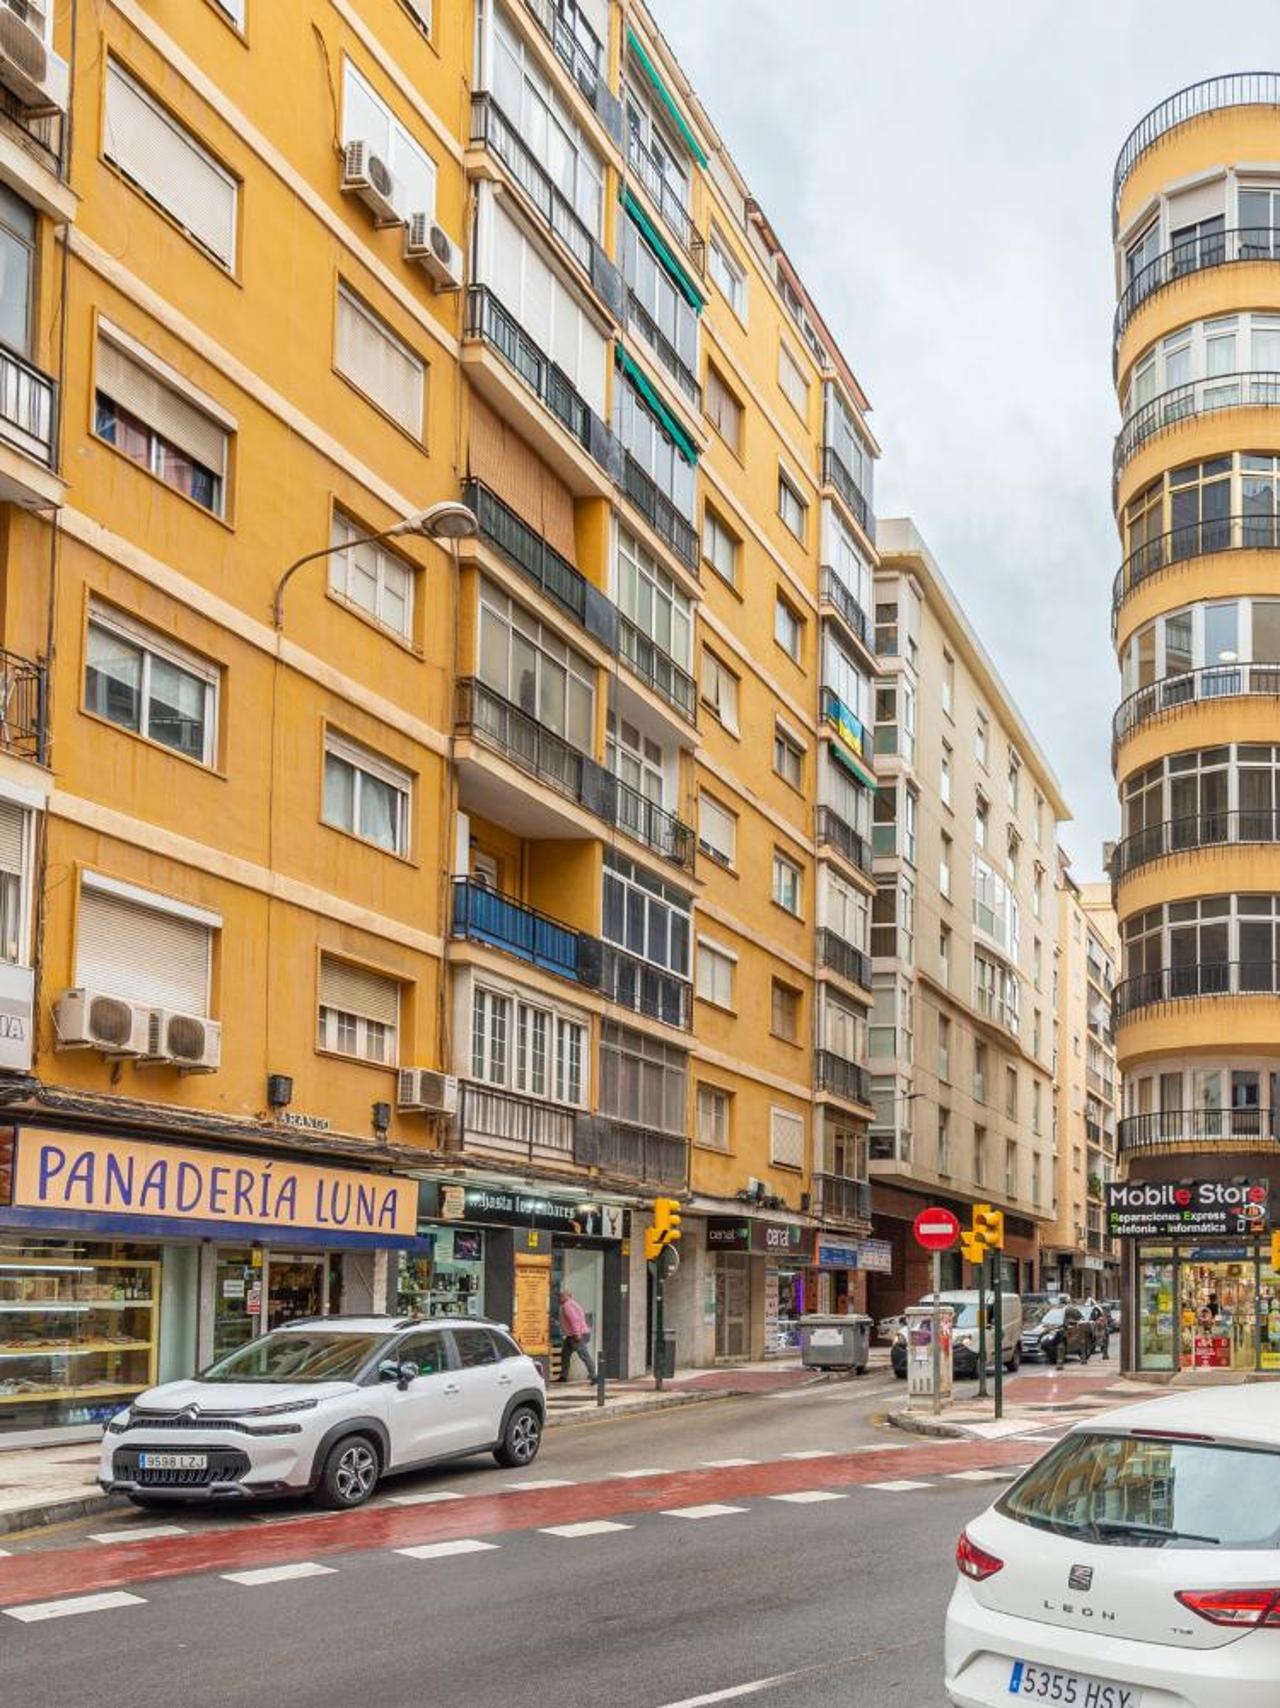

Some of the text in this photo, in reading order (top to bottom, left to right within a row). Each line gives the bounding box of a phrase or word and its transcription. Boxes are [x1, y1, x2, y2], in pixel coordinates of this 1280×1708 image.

[38, 1145, 298, 1221] PANADERÍA
[315, 1177, 399, 1230] LUNA
[1110, 1183, 1266, 1206] Mobile Store
[1111, 1210, 1227, 1223] Reparaciones Express
[180, 1456, 205, 1468] LZJ
[1044, 1600, 1115, 1620] LEON
[1023, 1668, 1131, 1708] 5355 HSY
